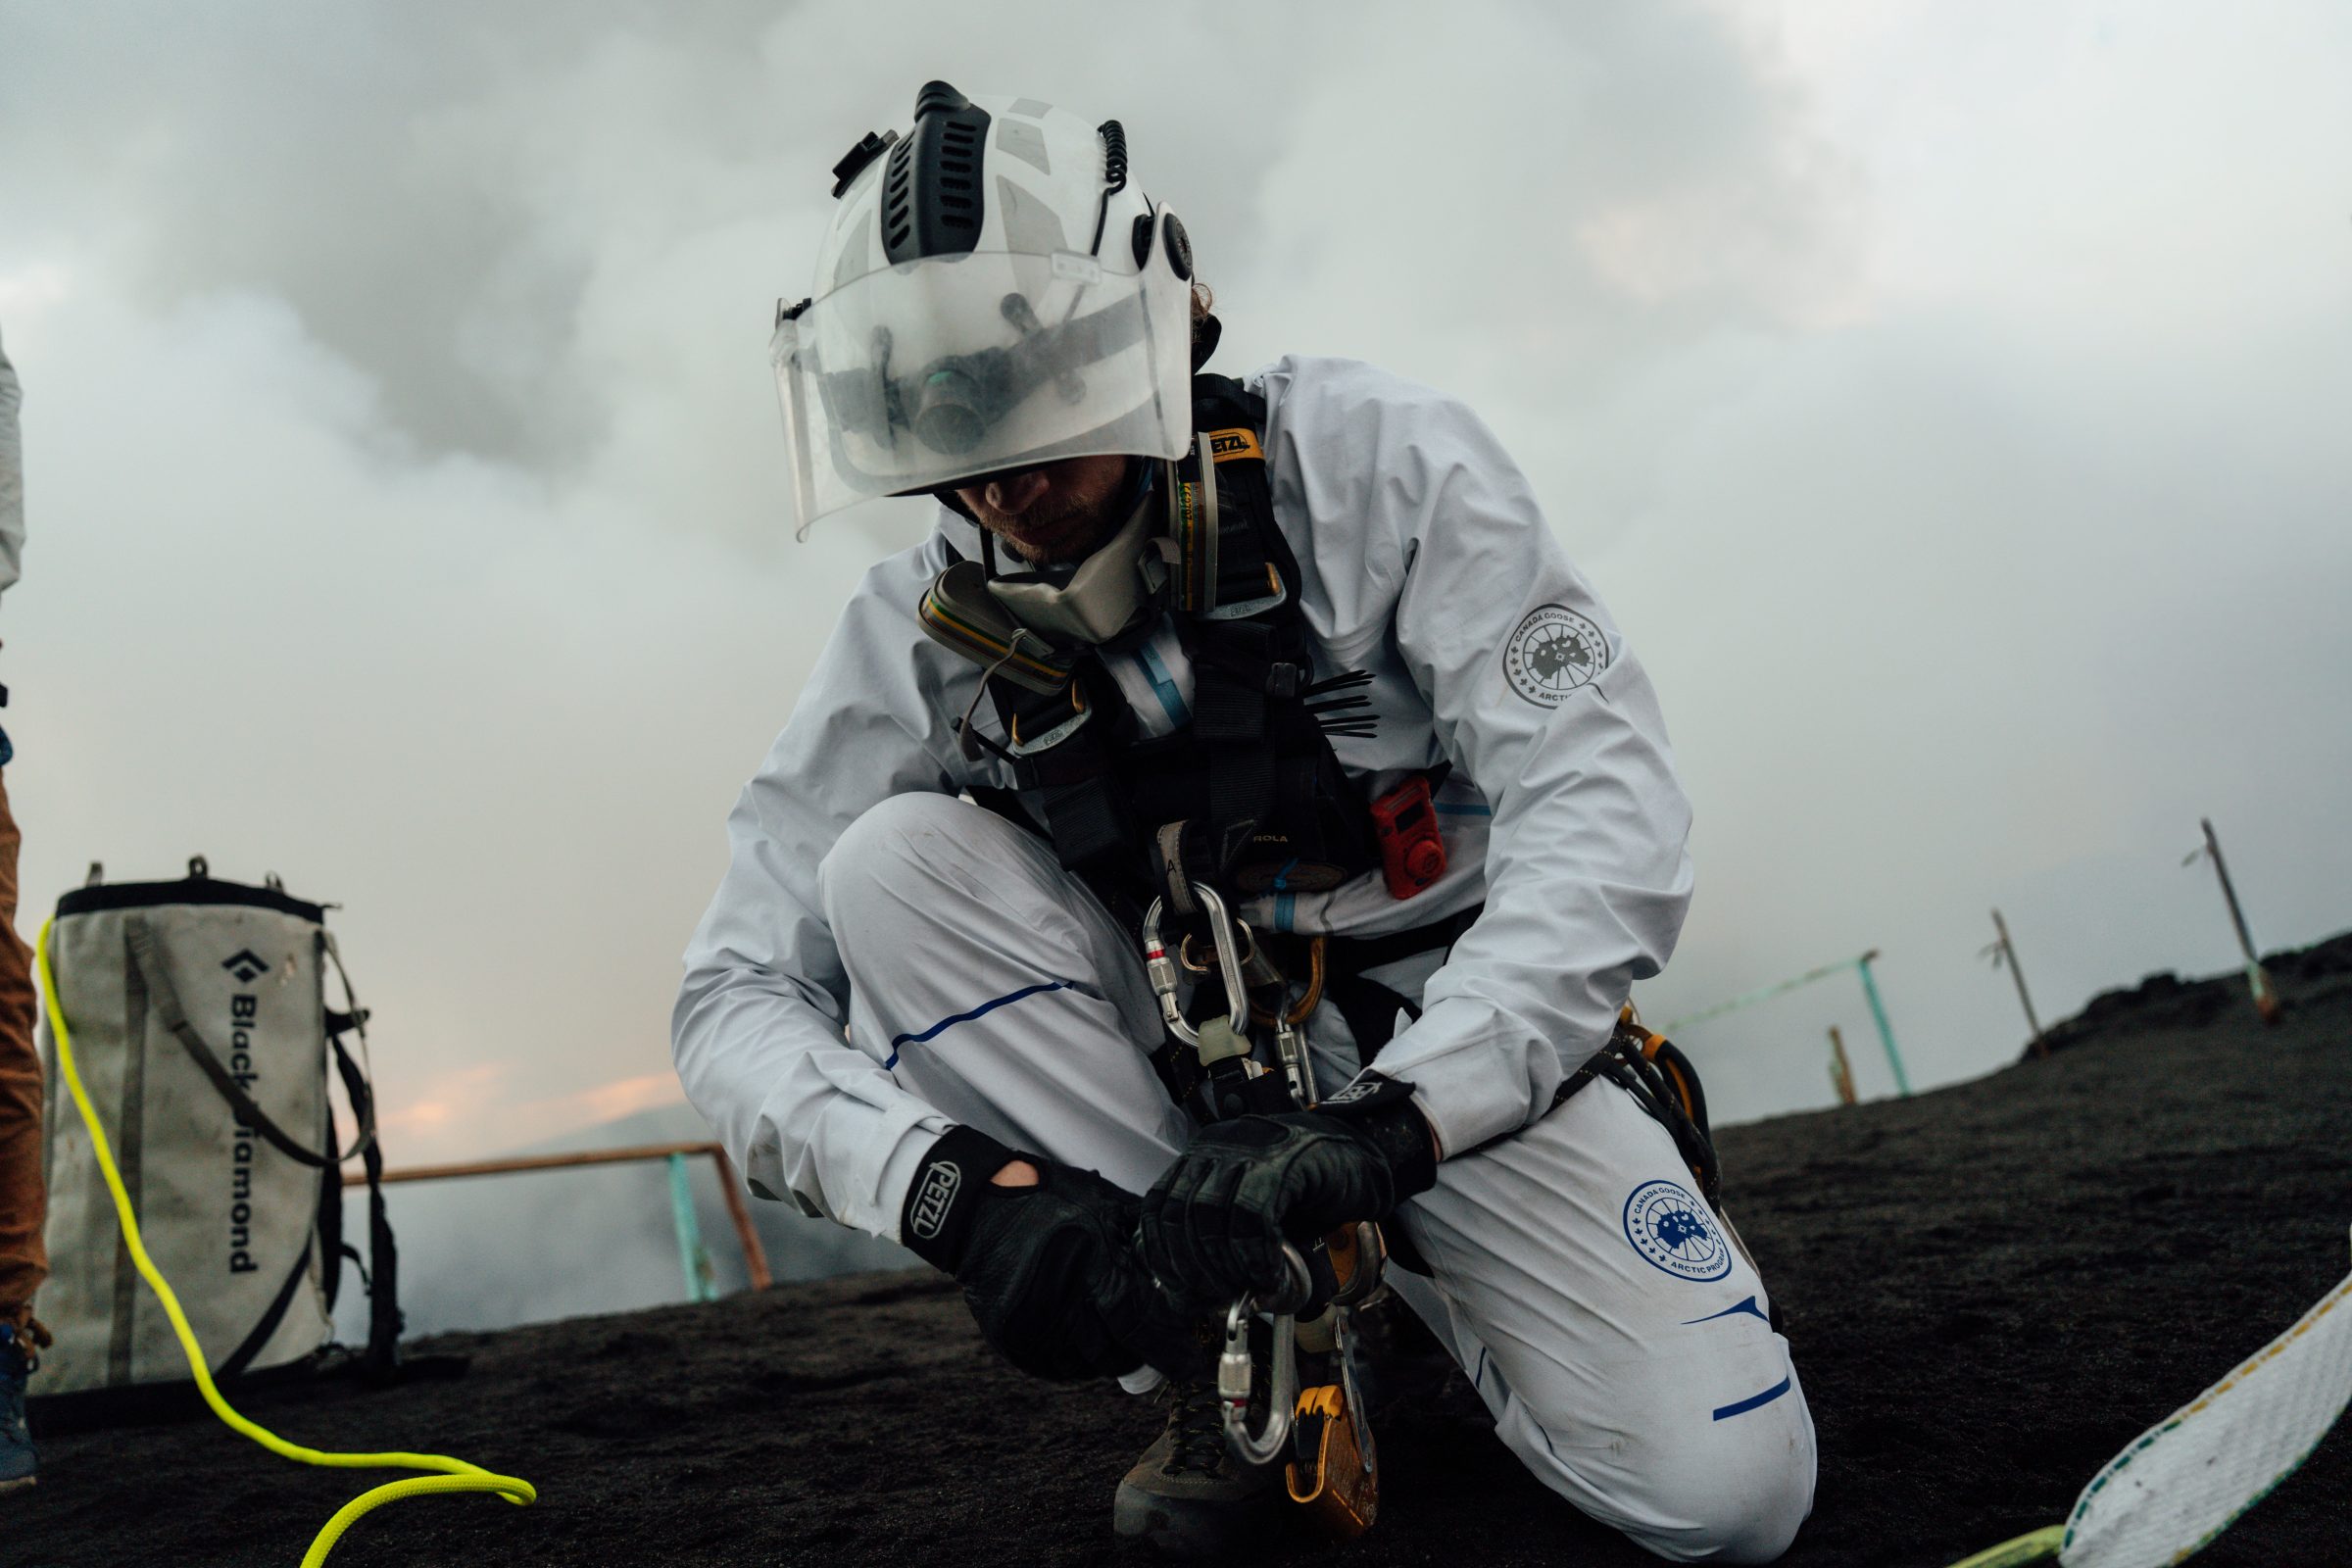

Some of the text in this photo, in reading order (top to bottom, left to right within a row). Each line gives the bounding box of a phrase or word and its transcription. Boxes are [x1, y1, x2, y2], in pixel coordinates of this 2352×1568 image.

[1210, 436, 1250, 453] ETZL
[1515, 612, 1575, 642] CANADA GOOSE
[1539, 692, 1572, 702] ARCT
[1253, 835, 1289, 844] ROLA
[231, 994, 257, 1090] Black
[913, 1161, 957, 1236] PETZL
[1634, 1187, 1686, 1214] CANADA GOOSE
[1670, 1261, 1707, 1274] ARCTIC
